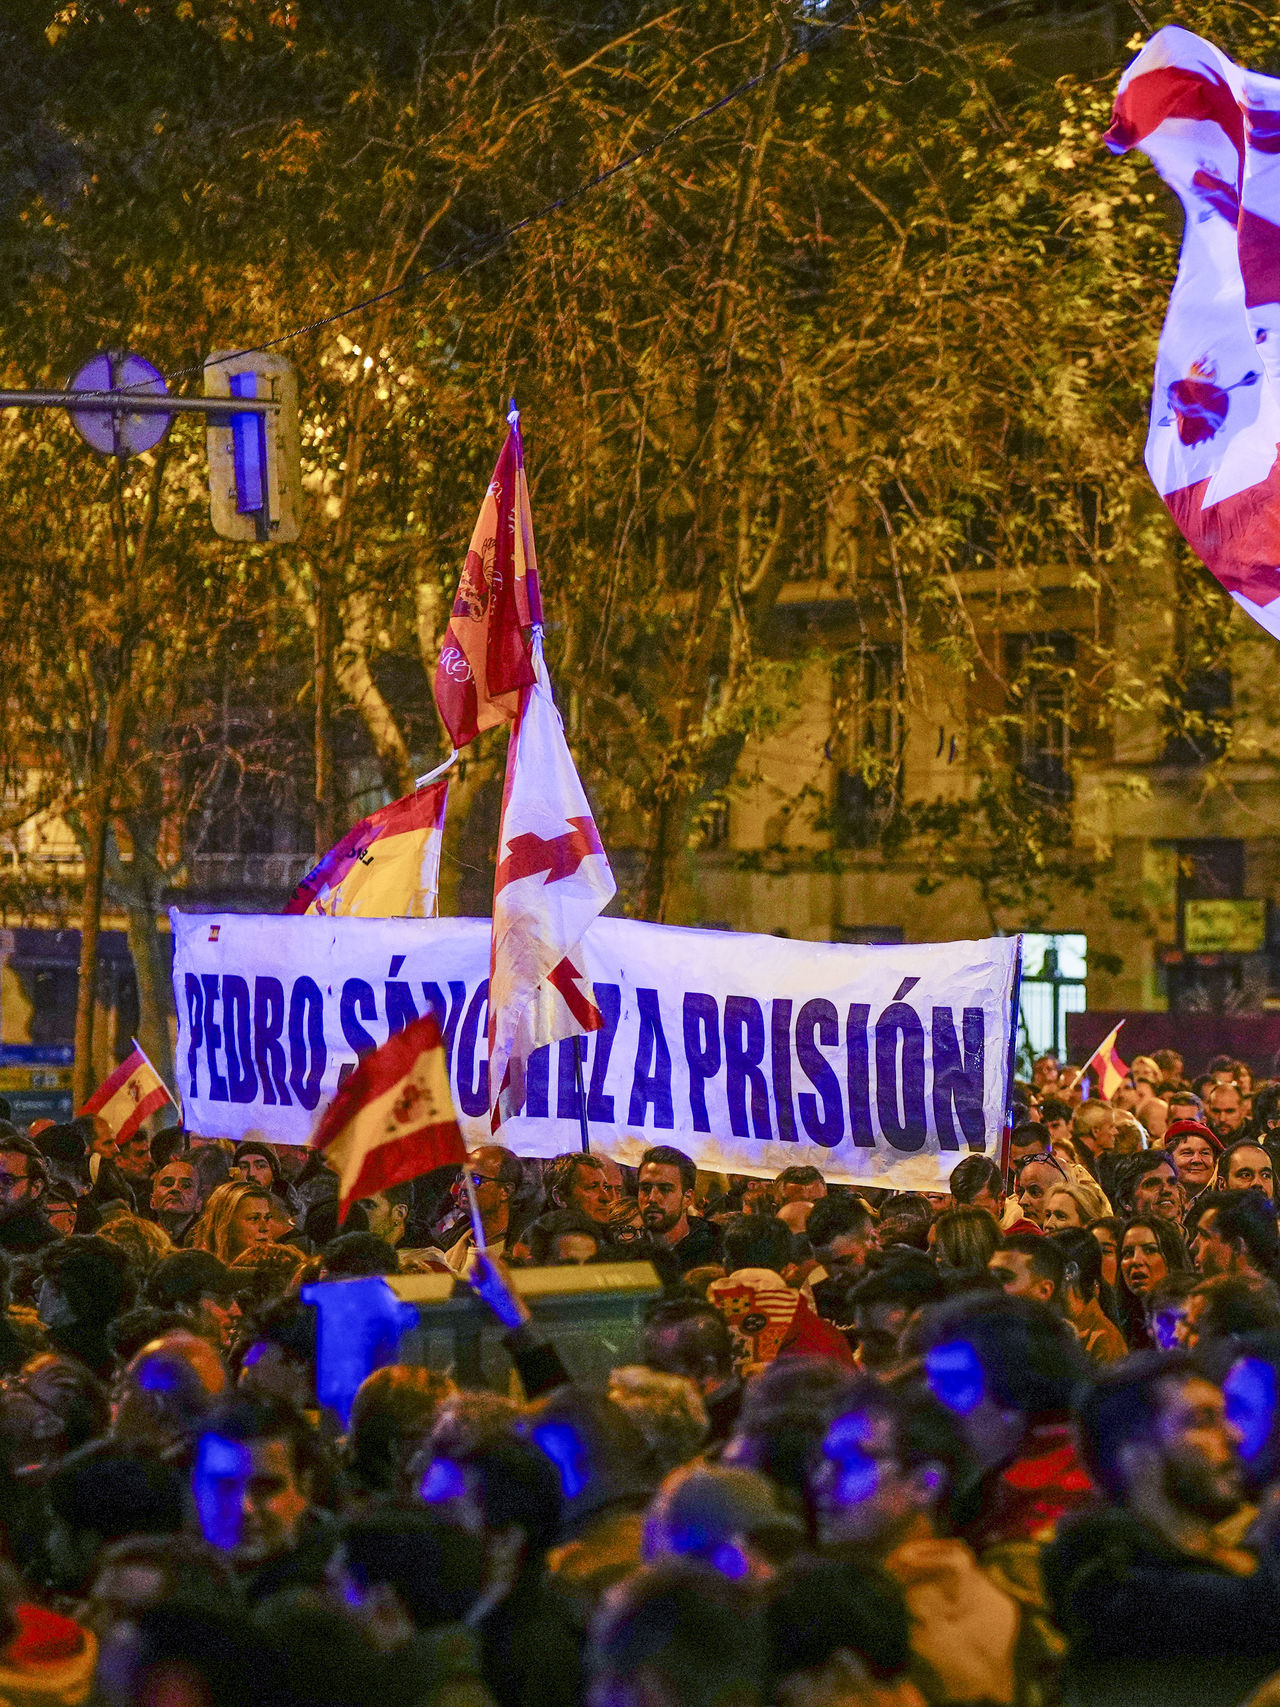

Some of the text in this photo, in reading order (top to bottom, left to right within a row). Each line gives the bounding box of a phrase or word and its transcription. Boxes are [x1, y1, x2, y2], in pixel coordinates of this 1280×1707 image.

[185, 972, 327, 1111] PEDRO
[627, 987, 674, 1129] A
[682, 976, 986, 1153] PRISIÓN
